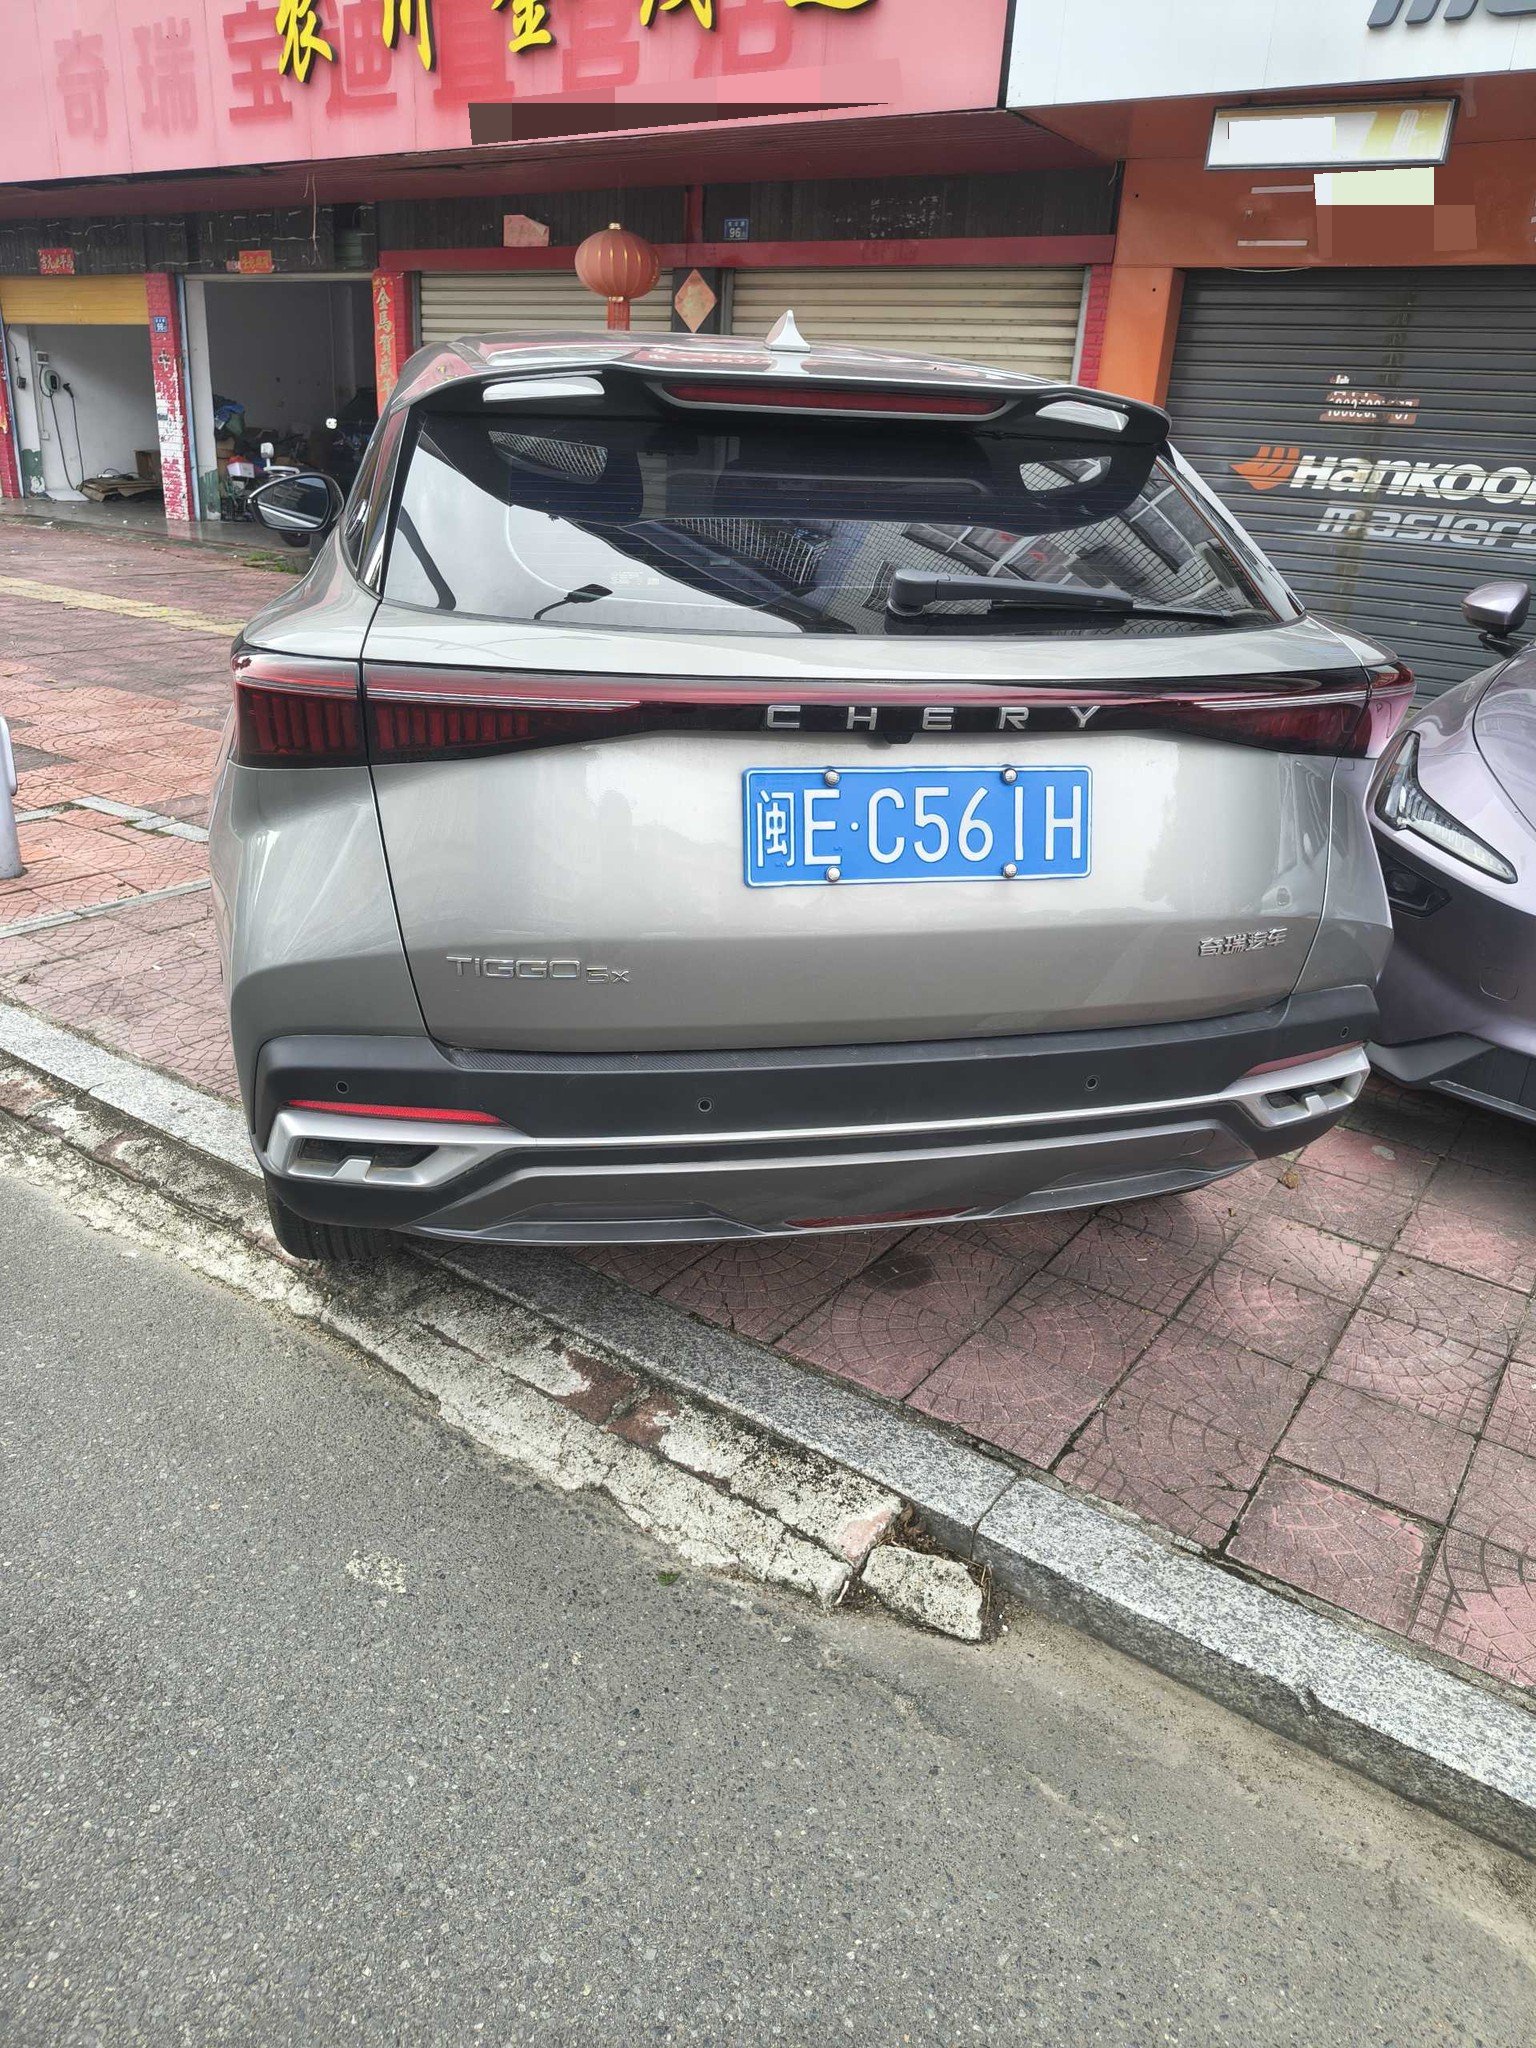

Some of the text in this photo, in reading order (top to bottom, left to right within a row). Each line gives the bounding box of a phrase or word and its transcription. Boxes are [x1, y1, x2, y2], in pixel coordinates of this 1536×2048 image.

[766, 704, 1100, 731] CHERY
[1199, 928, 1288, 957] 奇瑞汽车
[446, 956, 581, 979] TIGGO
